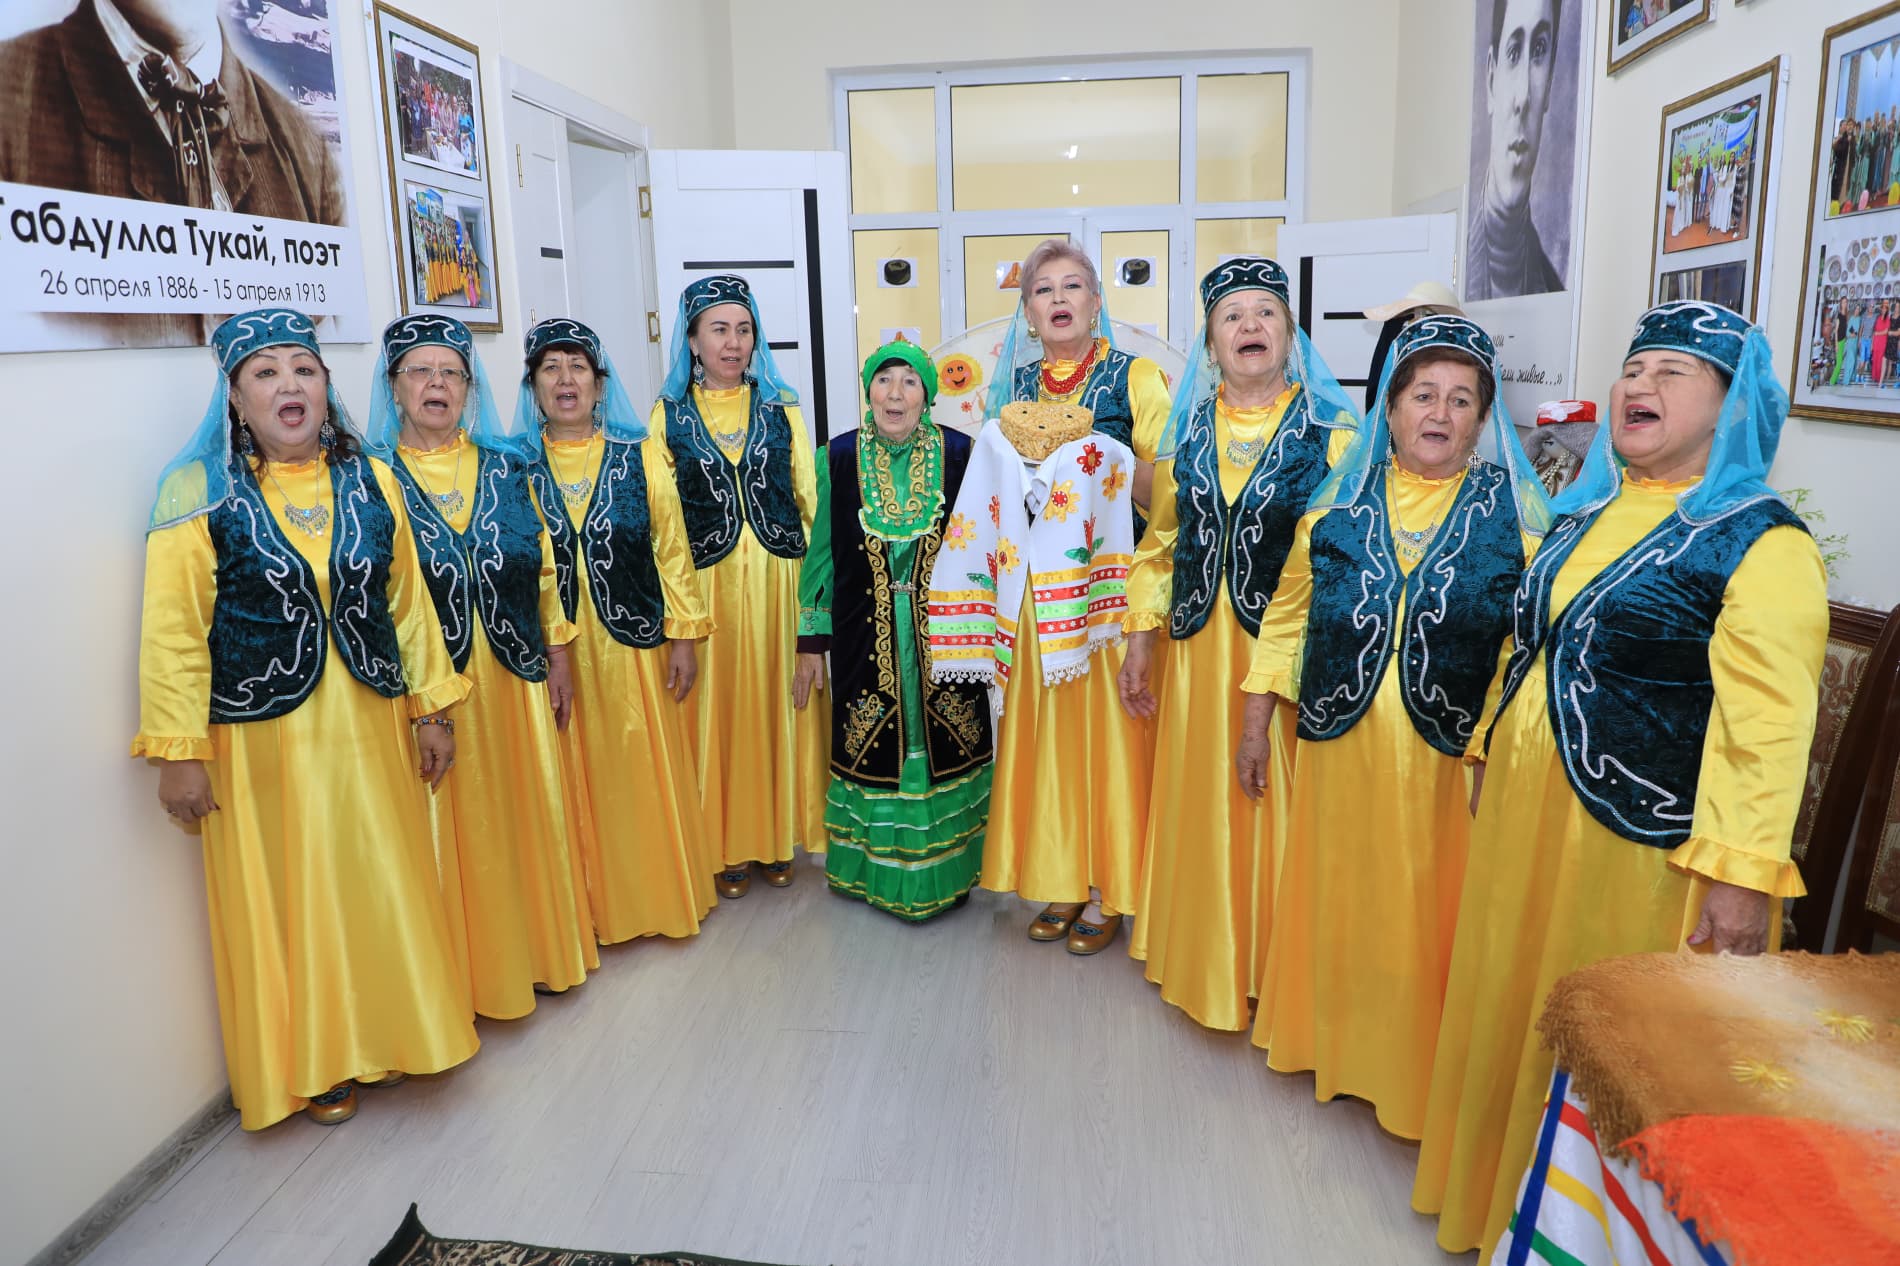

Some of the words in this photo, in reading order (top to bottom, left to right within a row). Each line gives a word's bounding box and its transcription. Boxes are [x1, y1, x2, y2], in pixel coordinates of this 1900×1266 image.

[0, 196, 178, 260] абдулла
[184, 217, 277, 267] Тукай,
[284, 238, 342, 267] поэт
[40, 269, 68, 296] 26
[75, 277, 152, 302] апреля
[157, 275, 199, 300] 1886
[213, 278, 232, 301] 15
[236, 285, 292, 306] апреля
[295, 282, 327, 304] 1913
